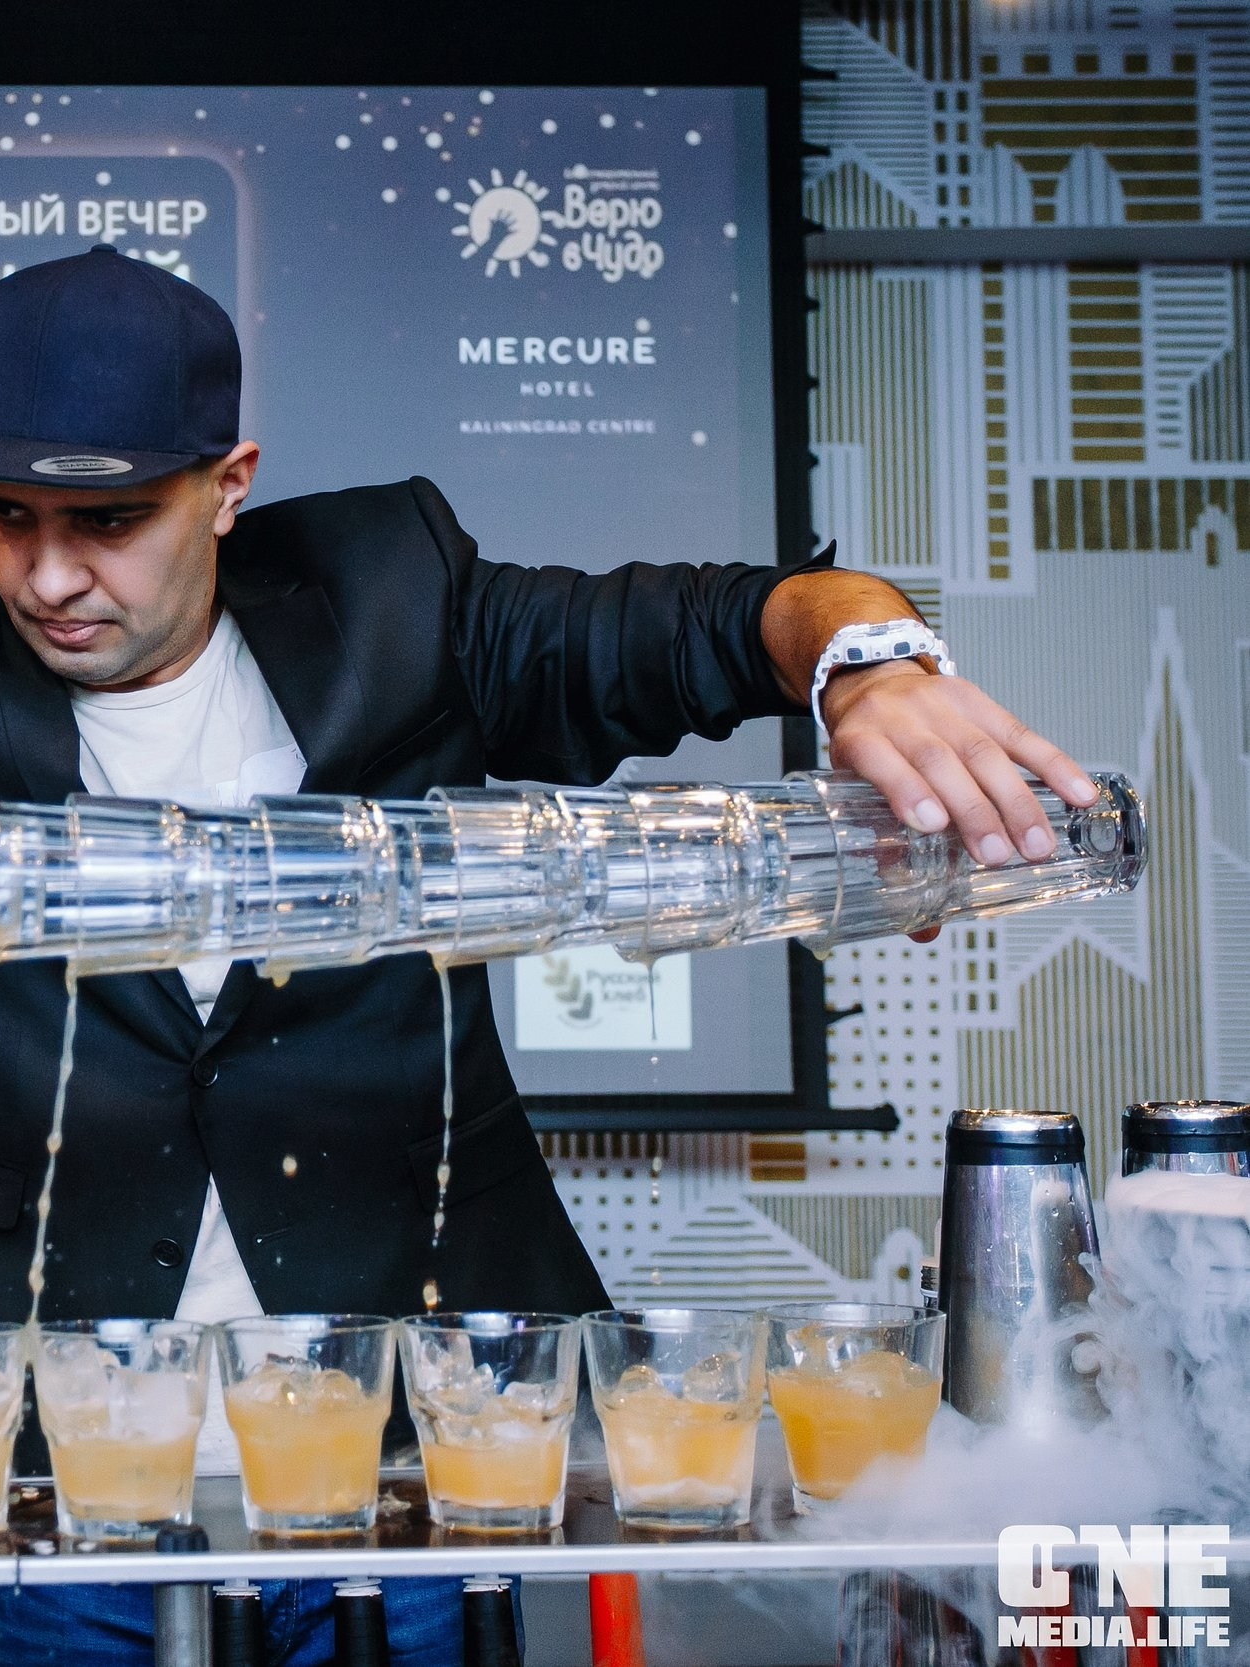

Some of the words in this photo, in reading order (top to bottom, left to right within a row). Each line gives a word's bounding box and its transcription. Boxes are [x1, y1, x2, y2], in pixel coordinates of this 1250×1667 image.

[77, 199, 208, 237] ВЕЧЕР
[563, 184, 662, 238] Верю
[458, 336, 657, 365] MERCURE
[519, 380, 595, 397] HOTEL
